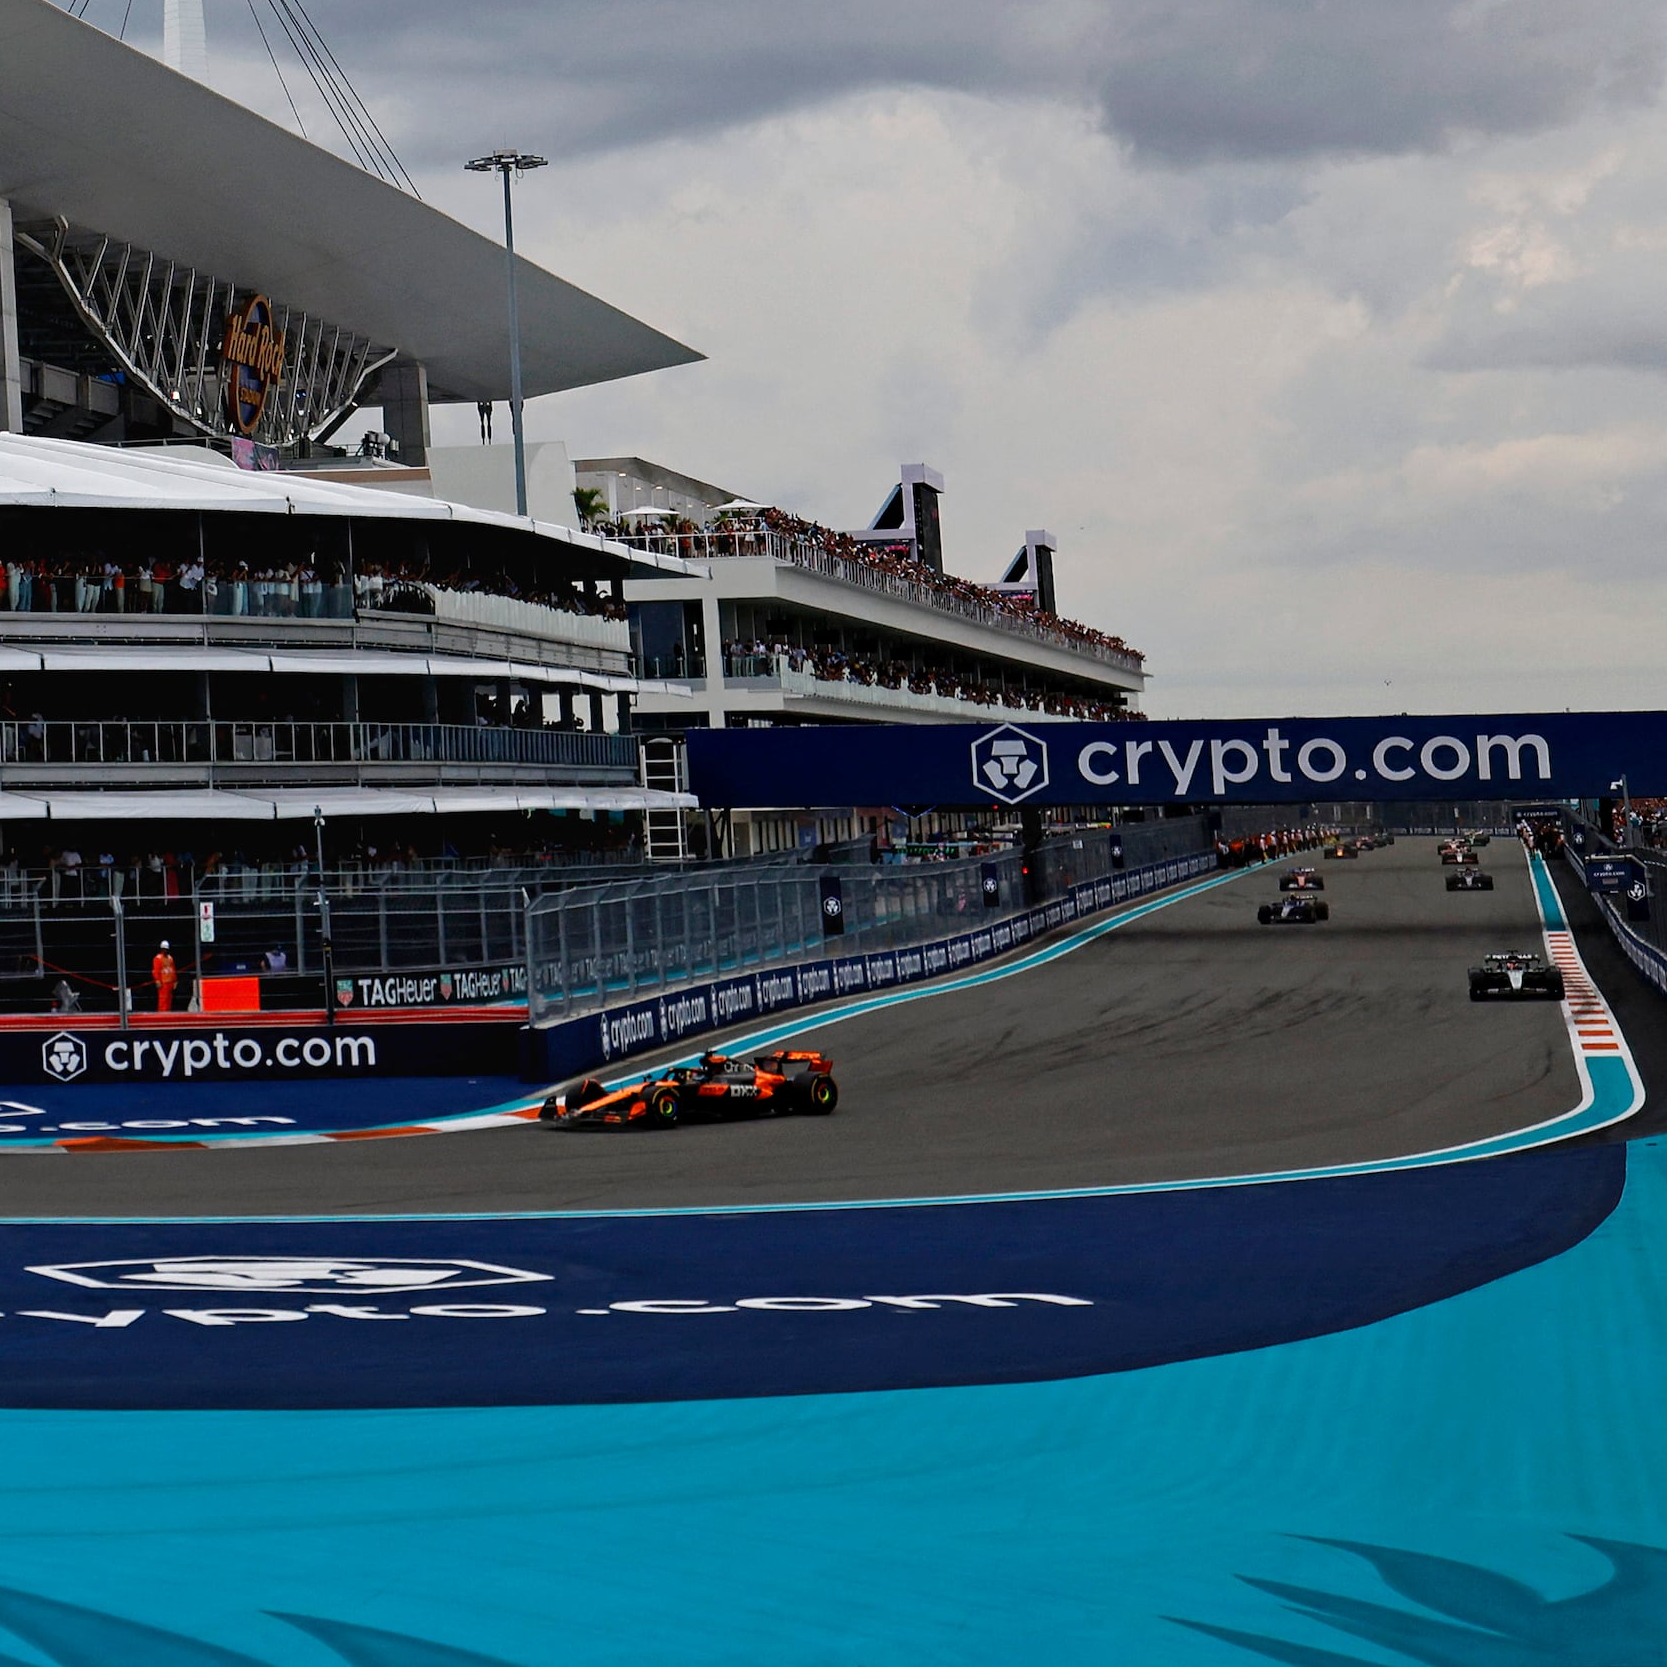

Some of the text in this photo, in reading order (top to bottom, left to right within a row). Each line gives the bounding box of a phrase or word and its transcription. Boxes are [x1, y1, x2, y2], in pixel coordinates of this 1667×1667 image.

[228, 314, 263, 367] Hard
[1078, 728, 1553, 796] crypto.com
[358, 977, 437, 1006] TAGHeuer
[717, 982, 753, 1020] crypto.com
[610, 1009, 655, 1053] crypto.com
[667, 994, 707, 1035] crypto.com
[104, 1032, 376, 1077] crypto.com
